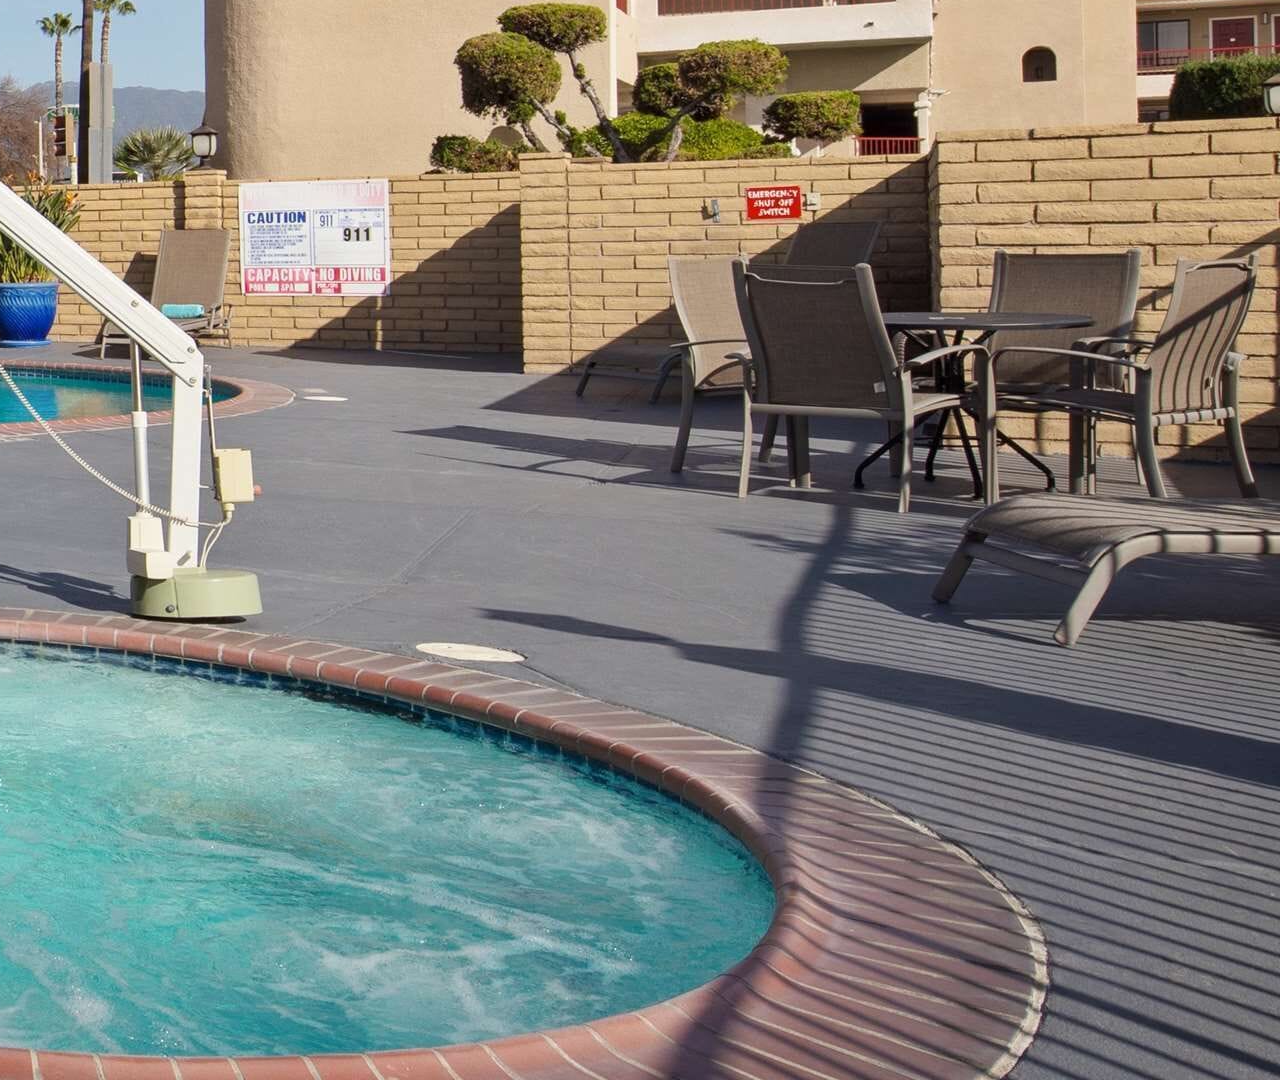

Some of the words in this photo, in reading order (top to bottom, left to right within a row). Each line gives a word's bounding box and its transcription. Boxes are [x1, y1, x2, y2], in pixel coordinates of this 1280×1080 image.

[748, 190, 798, 199] EMERGENCY
[753, 199, 775, 208] SHUT
[247, 211, 306, 224] CAUTION
[758, 208, 790, 216] SWITCH
[319, 215, 334, 228] 911
[343, 227, 371, 242] 911
[247, 269, 310, 282] CAPACITY
[319, 268, 335, 281] NO
[341, 268, 381, 281] DIVING
